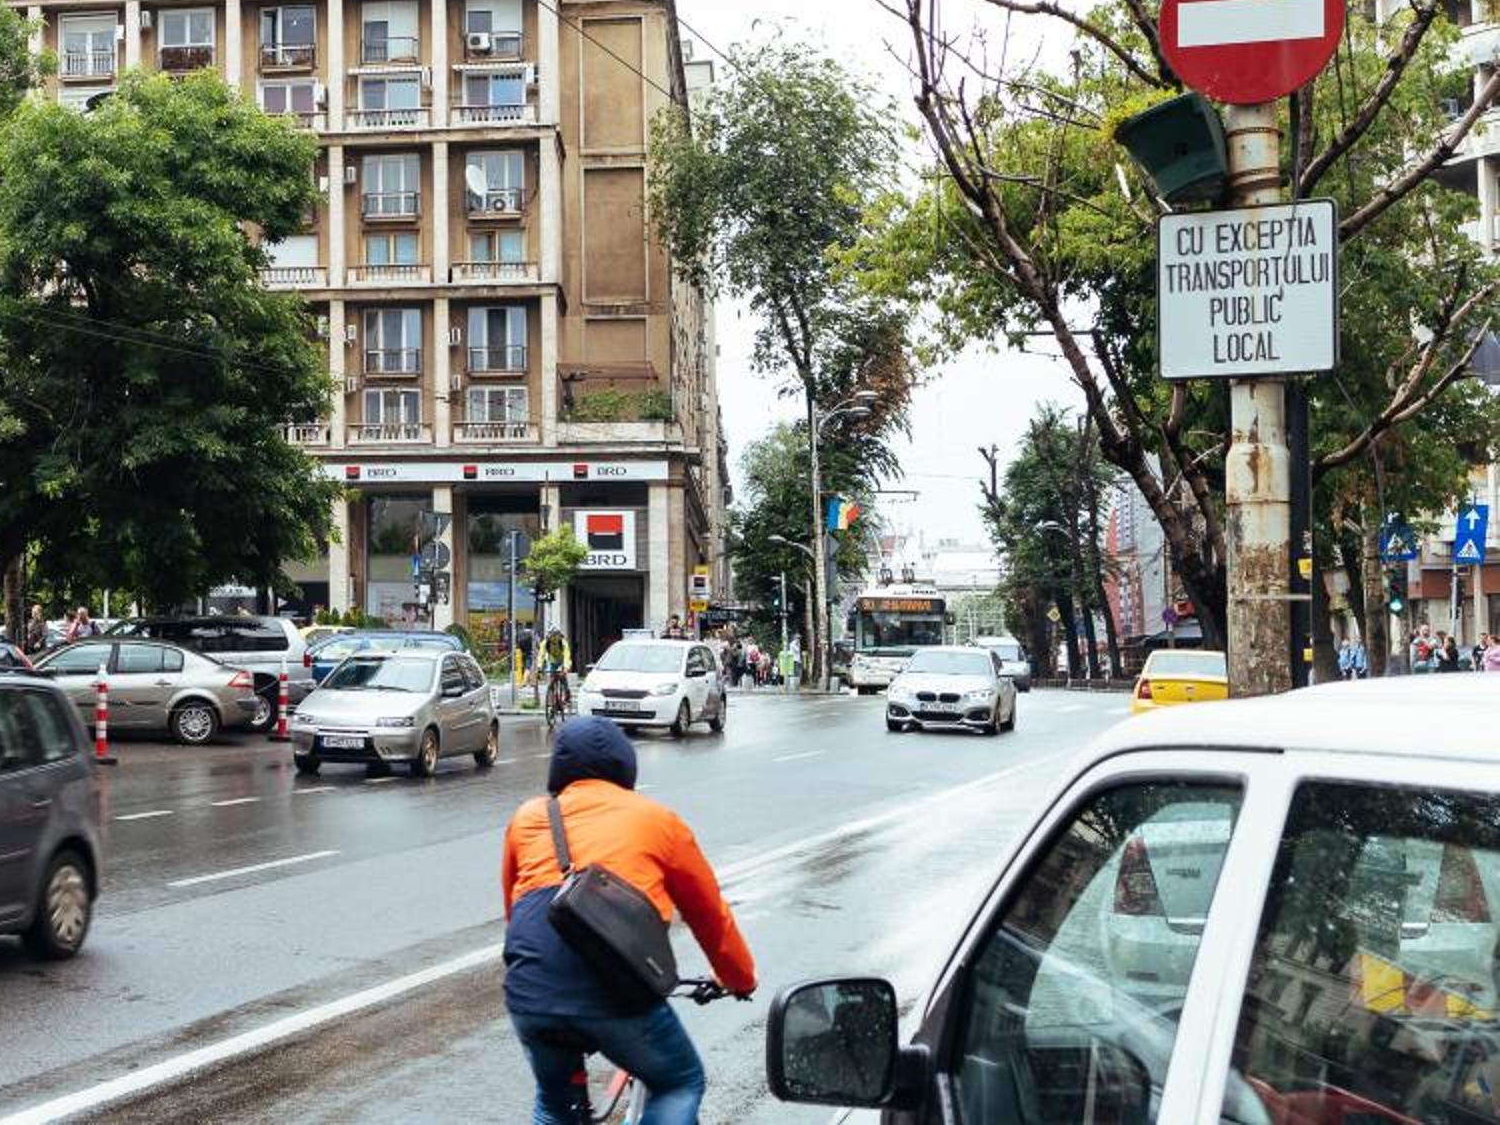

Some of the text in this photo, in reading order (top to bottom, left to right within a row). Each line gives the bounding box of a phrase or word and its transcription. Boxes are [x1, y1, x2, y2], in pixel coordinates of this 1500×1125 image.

[1177, 226, 1203, 256] CU
[1166, 252, 1330, 294] TRANSPORTULUI
[1210, 294, 1282, 327] PUBLIC
[1213, 331, 1281, 363] LOCAL
[597, 466, 627, 476] BRD
[583, 554, 627, 566] BRD
